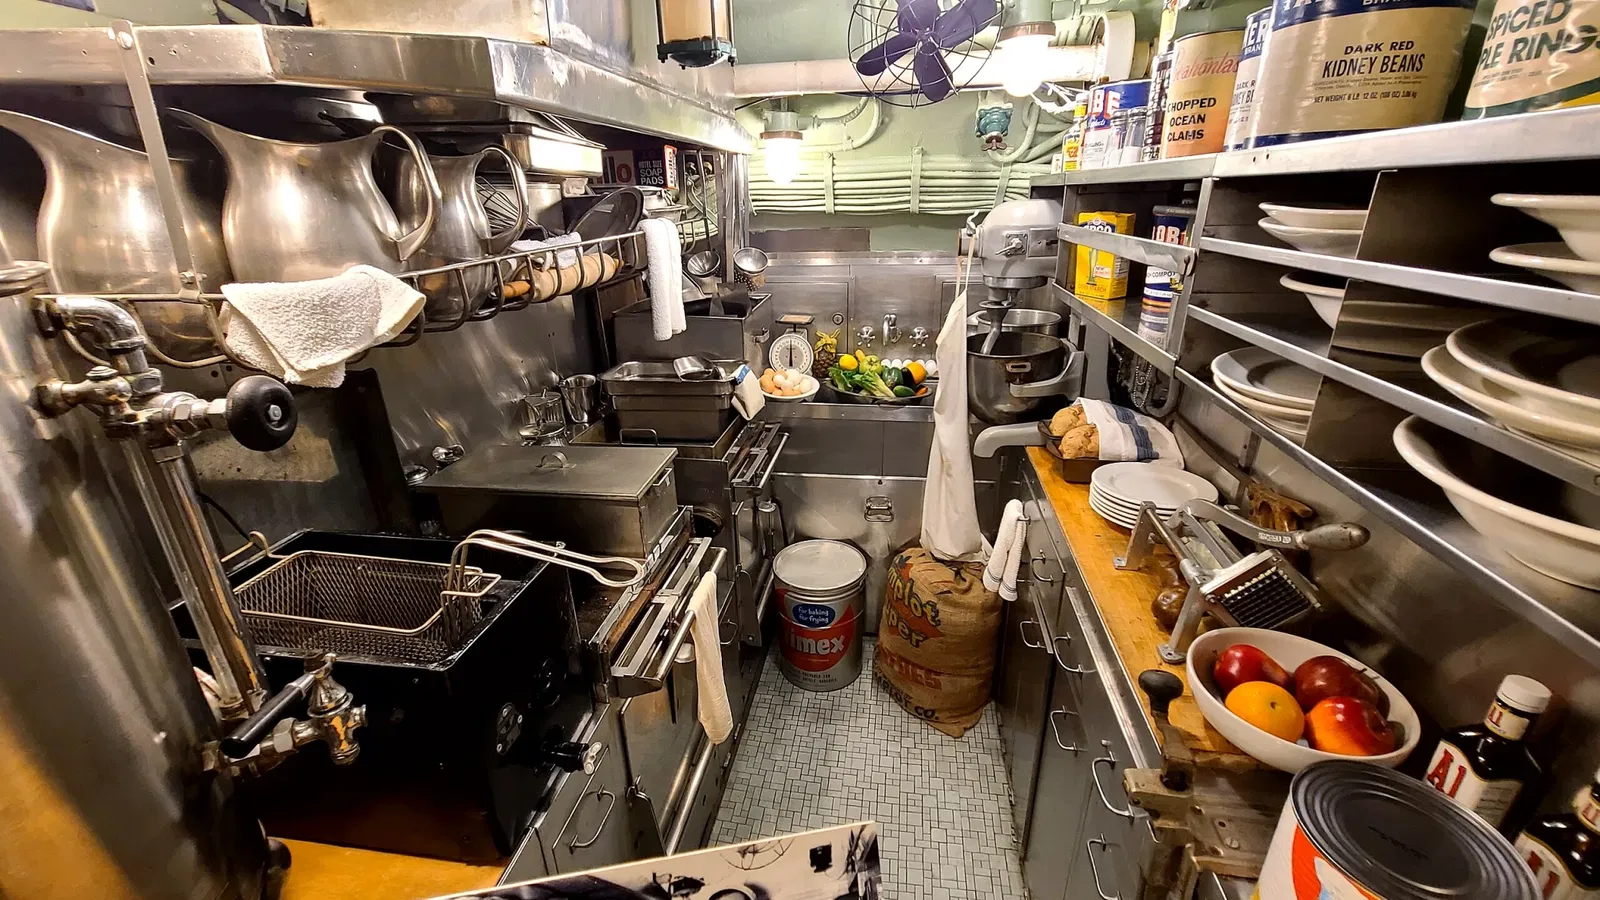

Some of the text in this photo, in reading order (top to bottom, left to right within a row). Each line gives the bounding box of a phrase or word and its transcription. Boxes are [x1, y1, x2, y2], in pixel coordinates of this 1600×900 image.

[1487, 0, 1573, 41] SPICED
[1344, 41, 1415, 55] DARK RED
[1478, 25, 1600, 71] PLE RING
[1322, 53, 1425, 78] KIDNEY BEANS
[1167, 97, 1217, 113] CHOPPED
[1325, 93, 1347, 103] WEIGHT
[1169, 114, 1206, 127] OCEAN
[1167, 129, 1204, 143] CLAMS
[640, 168, 663, 177] SOAP
[640, 176, 665, 185] PADS
[808, 608, 829, 616] baking
[809, 615, 829, 624] frying
[785, 628, 846, 655] imex
